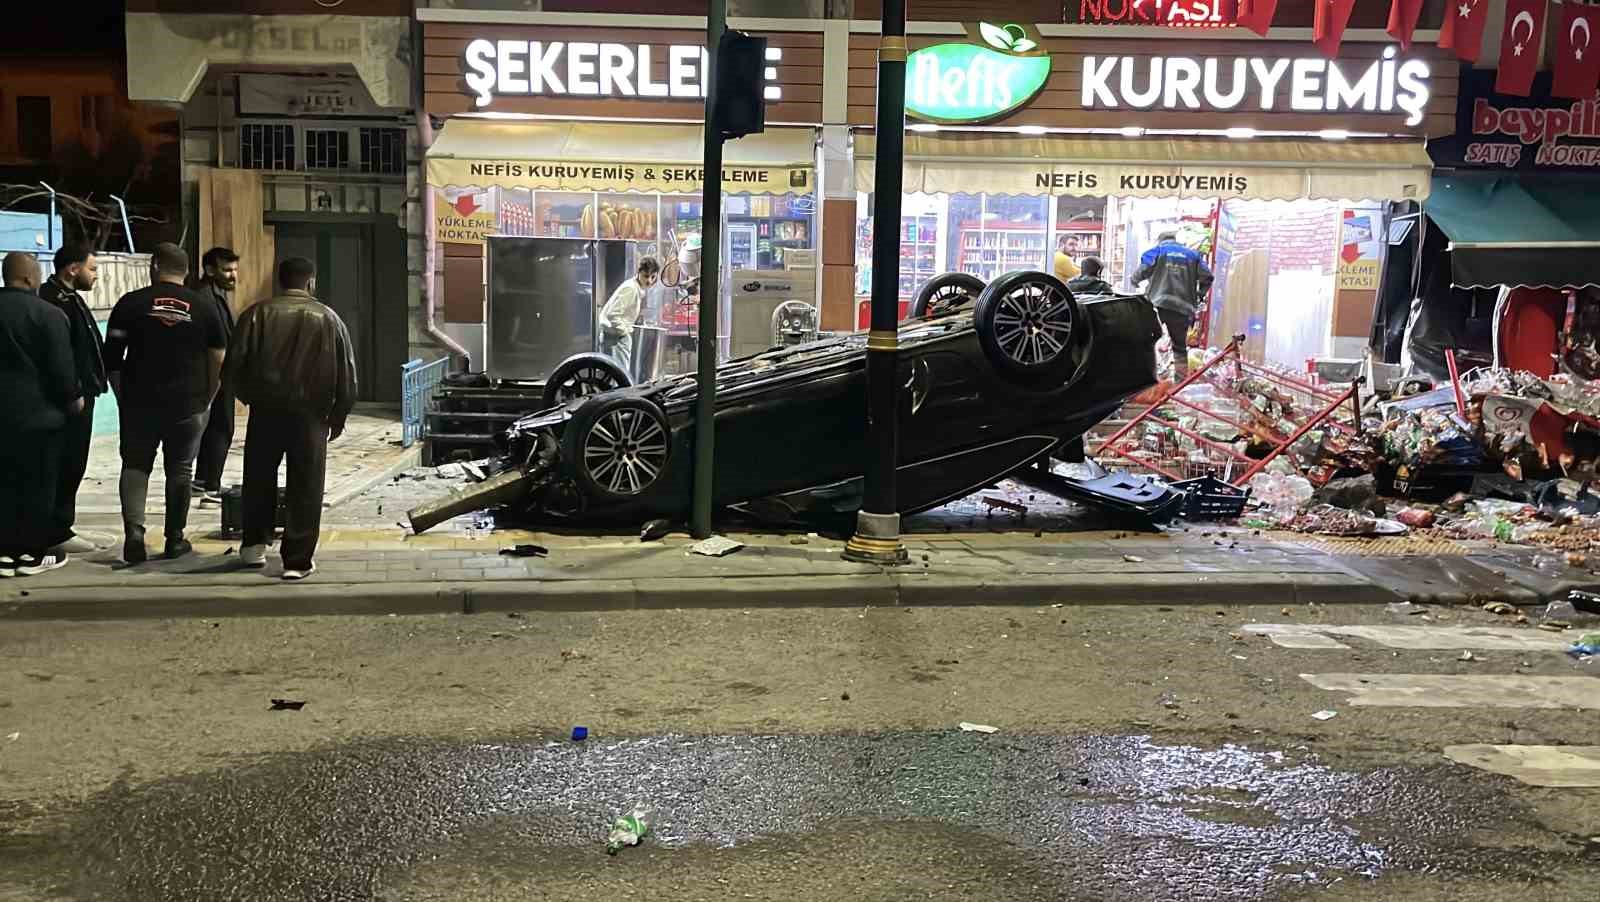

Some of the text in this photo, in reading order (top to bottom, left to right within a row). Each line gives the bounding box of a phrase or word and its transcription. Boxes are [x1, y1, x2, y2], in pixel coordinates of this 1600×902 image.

[1081, 45, 1430, 126] KURUYEMİŞ
[470, 162, 769, 183] NEFİS KURUYEMİŞ & ŞEKELEME
[1035, 170, 1248, 194] NEFİS KURUYEMİŞ
[438, 216, 493, 229] YÜKLEME
